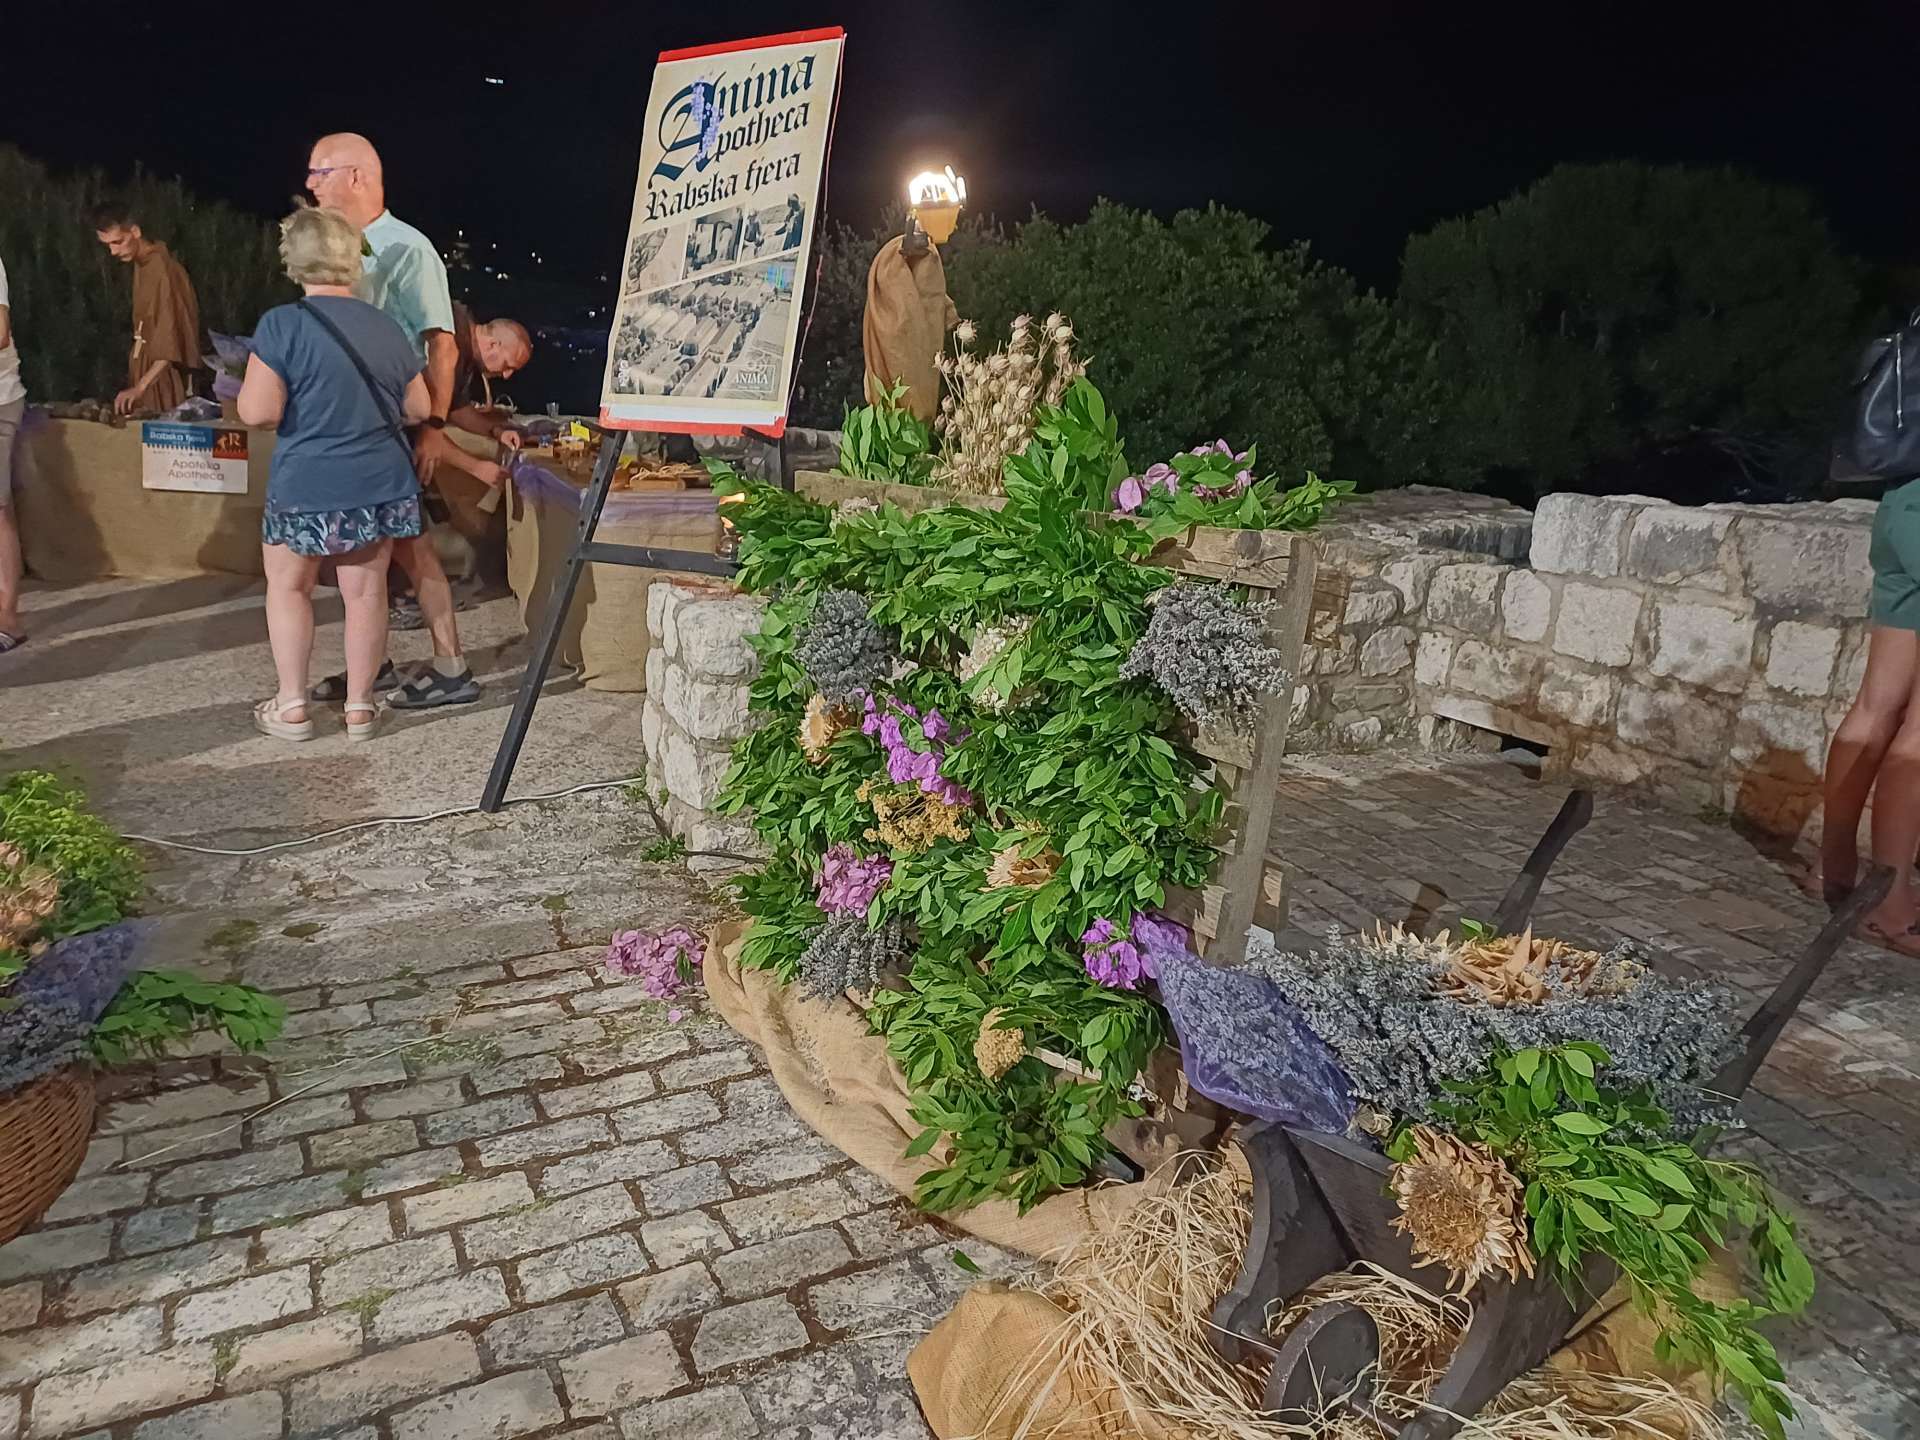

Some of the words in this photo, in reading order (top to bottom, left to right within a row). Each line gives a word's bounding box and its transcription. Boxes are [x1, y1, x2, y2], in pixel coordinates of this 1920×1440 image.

[642, 171, 738, 223] Rabska
[744, 152, 802, 196] fjera
[167, 469, 225, 481] Apotheca
